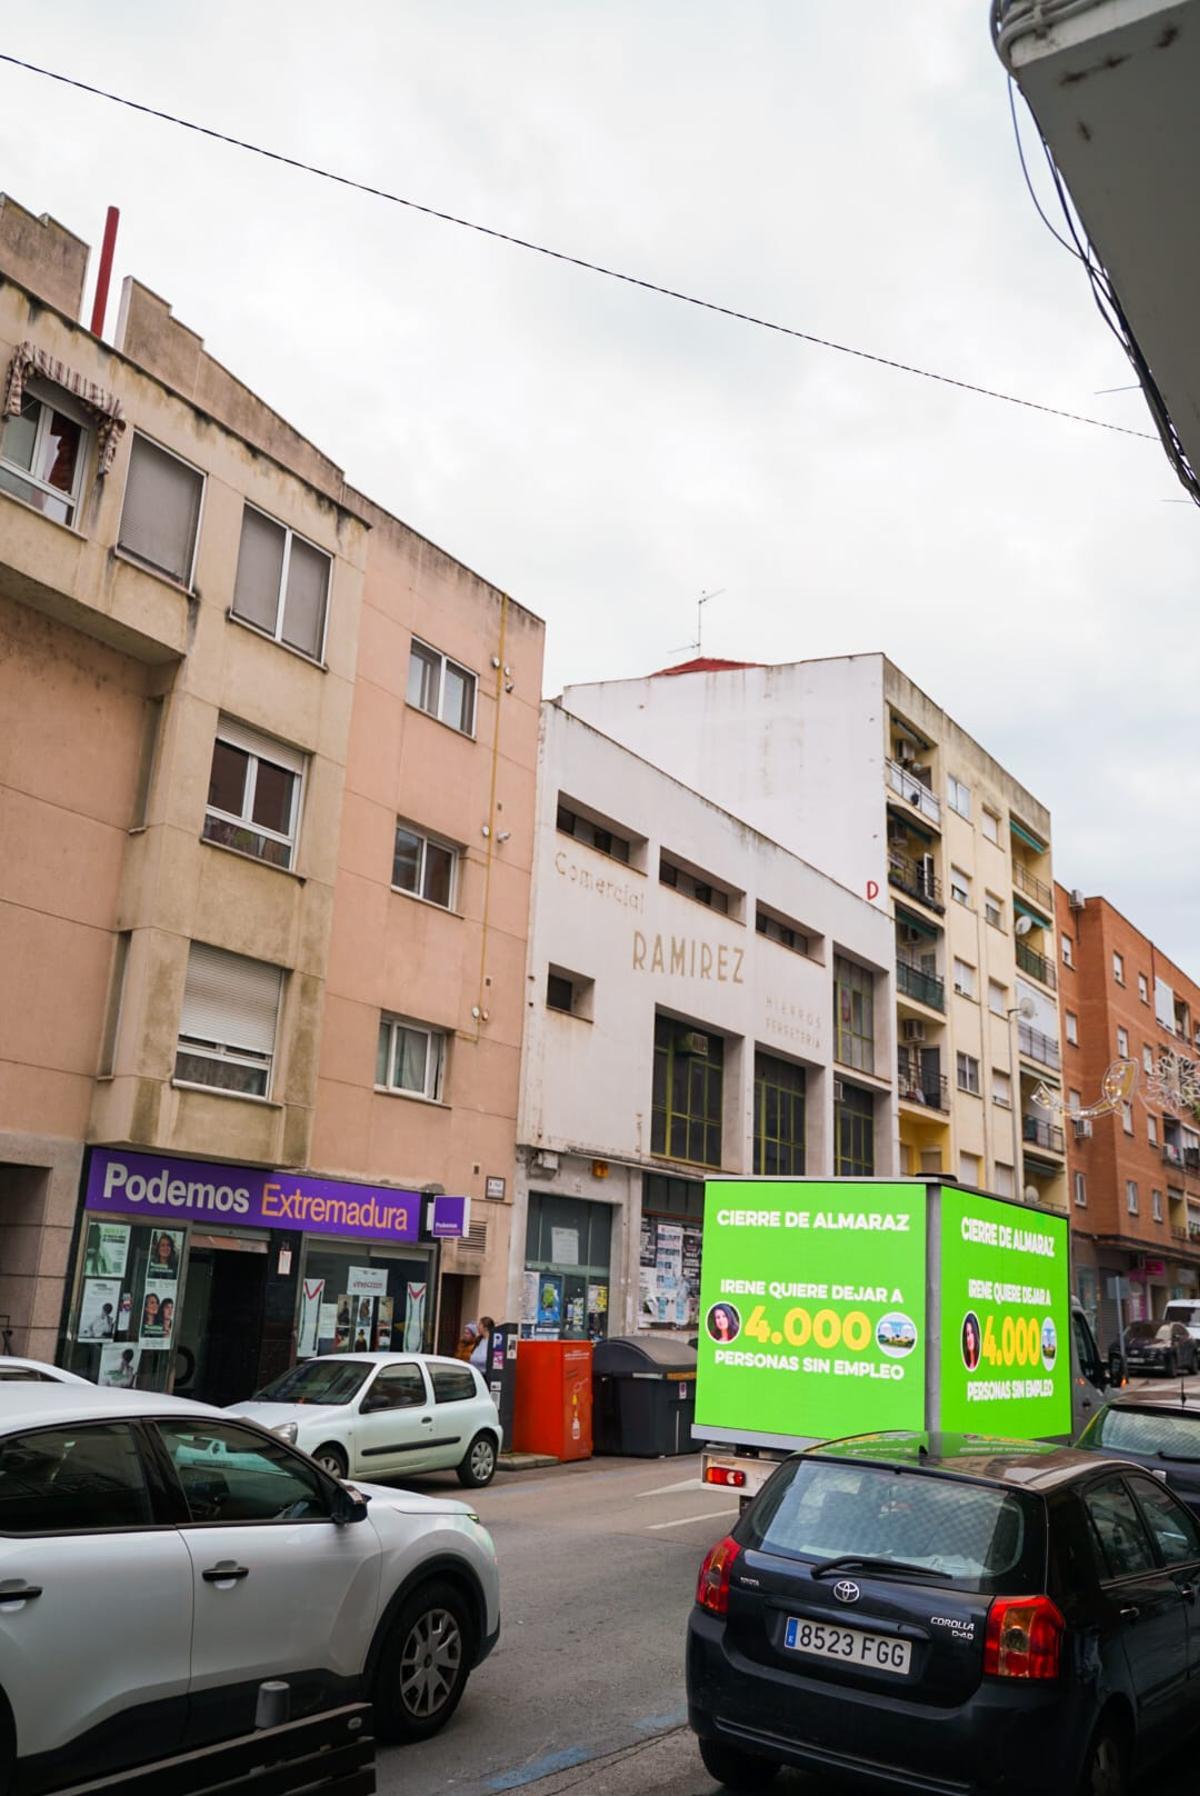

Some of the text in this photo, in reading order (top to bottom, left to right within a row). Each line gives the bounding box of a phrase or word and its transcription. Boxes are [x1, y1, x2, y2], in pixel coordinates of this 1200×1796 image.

[555, 851, 645, 915] Comercial
[866, 880, 879, 900] D
[633, 930, 745, 984] RAMIREZ
[103, 1162, 408, 1231] Podemos Extremadura
[717, 1209, 910, 1231] CIERRE DE ALMARAZ
[961, 1216, 1055, 1257] CIERRE DE ALMARAZ
[720, 1279, 904, 1303] IRENE QUIERE DEJAR A
[968, 1278, 1052, 1306] IRENE QUIERE DEJAR A
[744, 1305, 872, 1351] 4.000
[982, 1315, 1041, 1367] 4.000
[715, 1350, 904, 1380] PERSONAS SIN EMPLEO
[967, 1379, 1054, 1402] PERSONAS SIN EMPLEO
[930, 1616, 975, 1631] COROLLA
[800, 1624, 905, 1668] 8523 FGG
